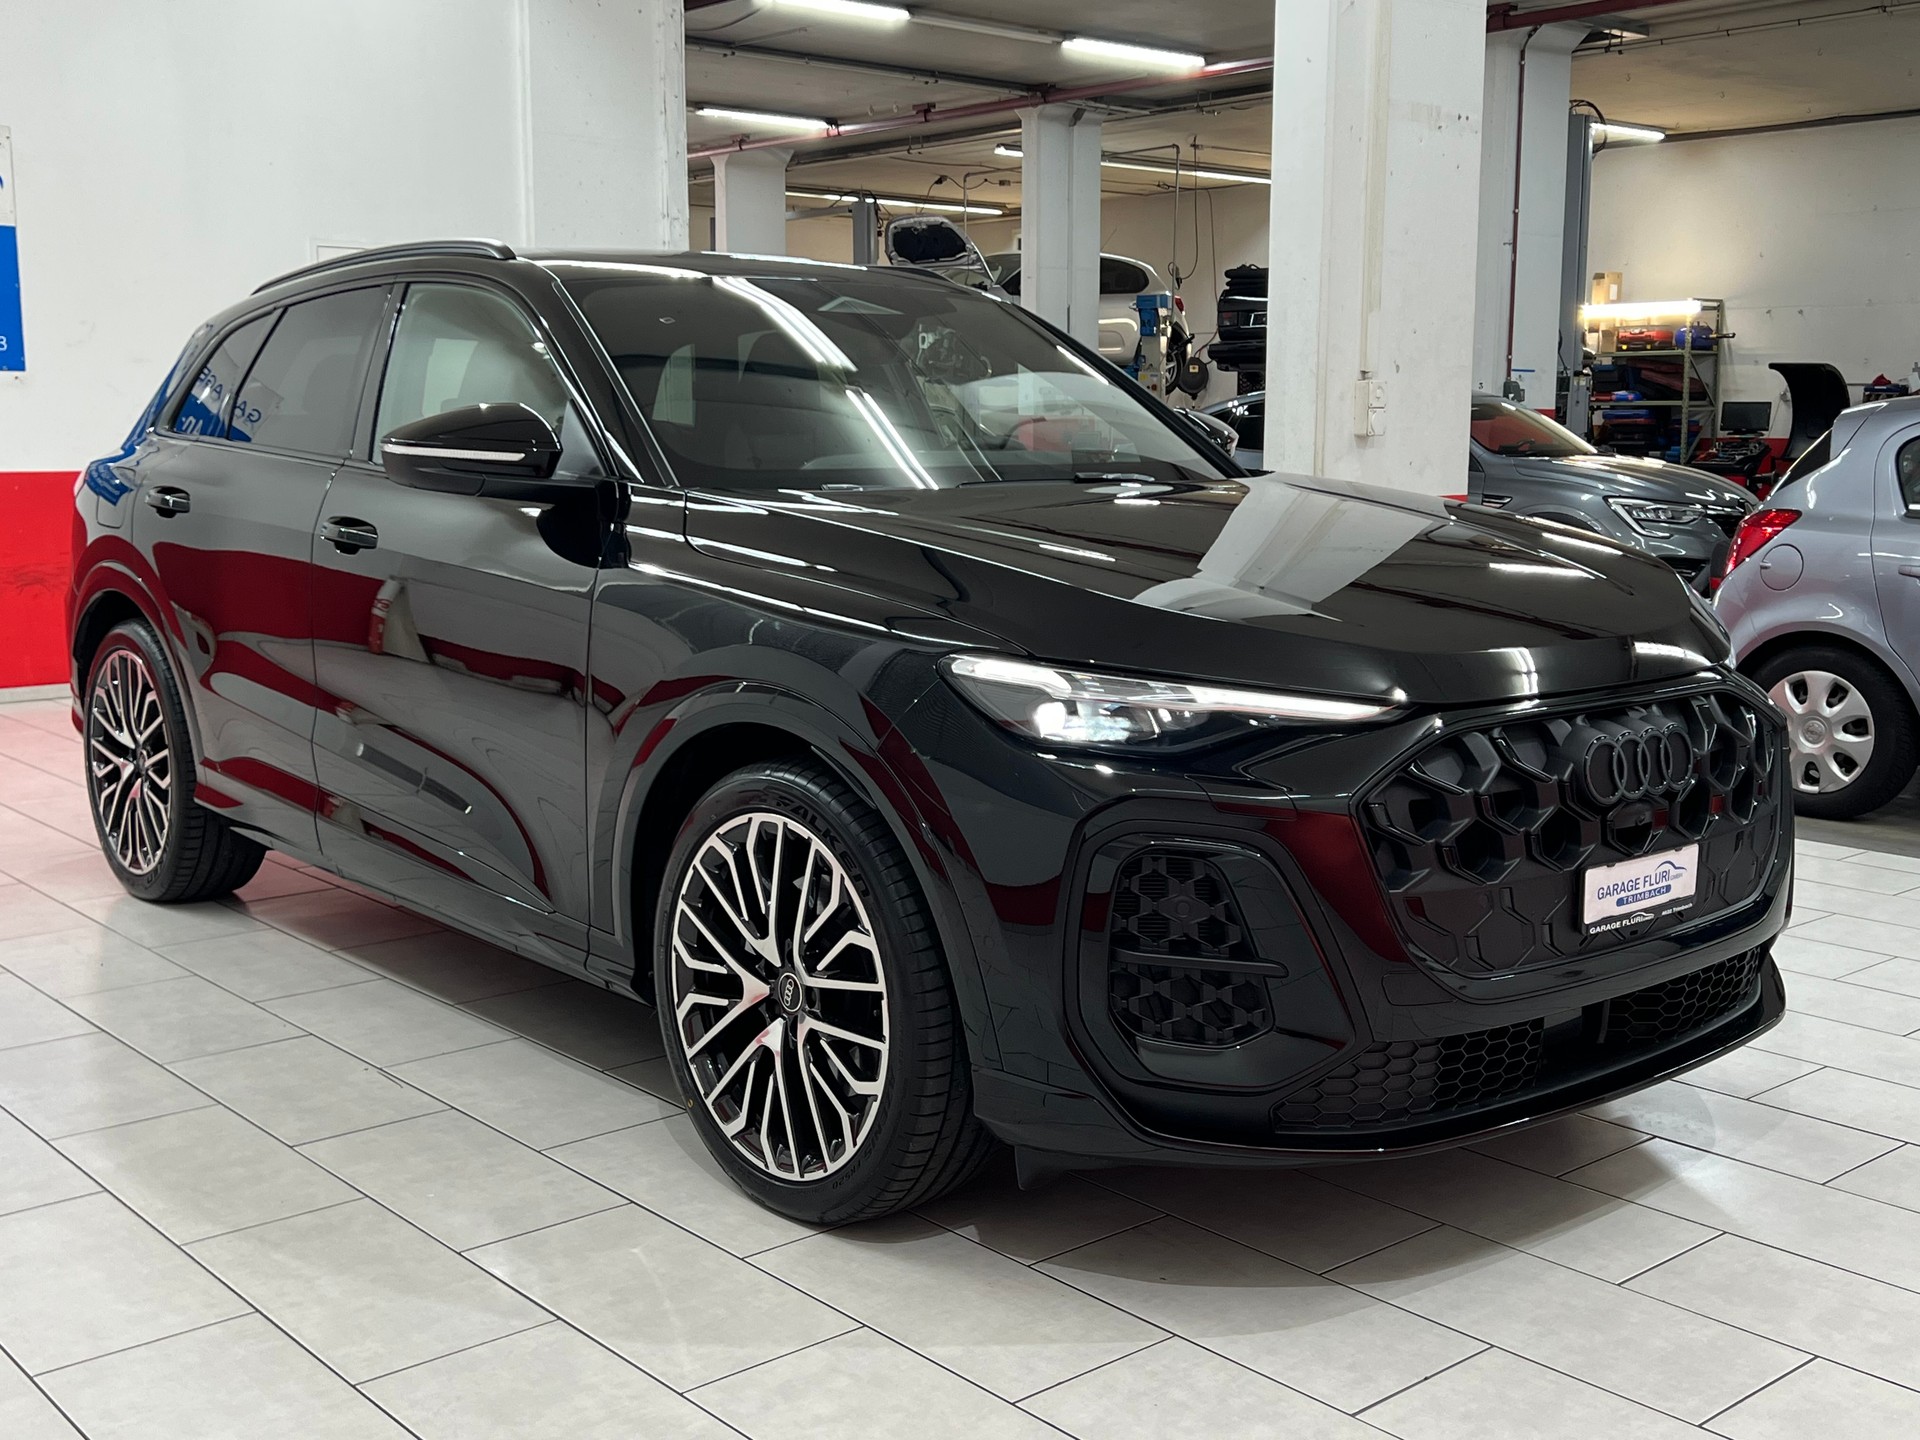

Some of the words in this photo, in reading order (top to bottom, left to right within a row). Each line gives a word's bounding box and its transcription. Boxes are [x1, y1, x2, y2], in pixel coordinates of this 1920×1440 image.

[775, 795, 871, 898] FALKEN
[1597, 878, 1640, 900] GARAGE
[1643, 869, 1670, 888] FLURI
[1622, 886, 1667, 904] TRIMBACH
[1589, 920, 1621, 934] GARAGE
[1622, 915, 1643, 927] FLURI
